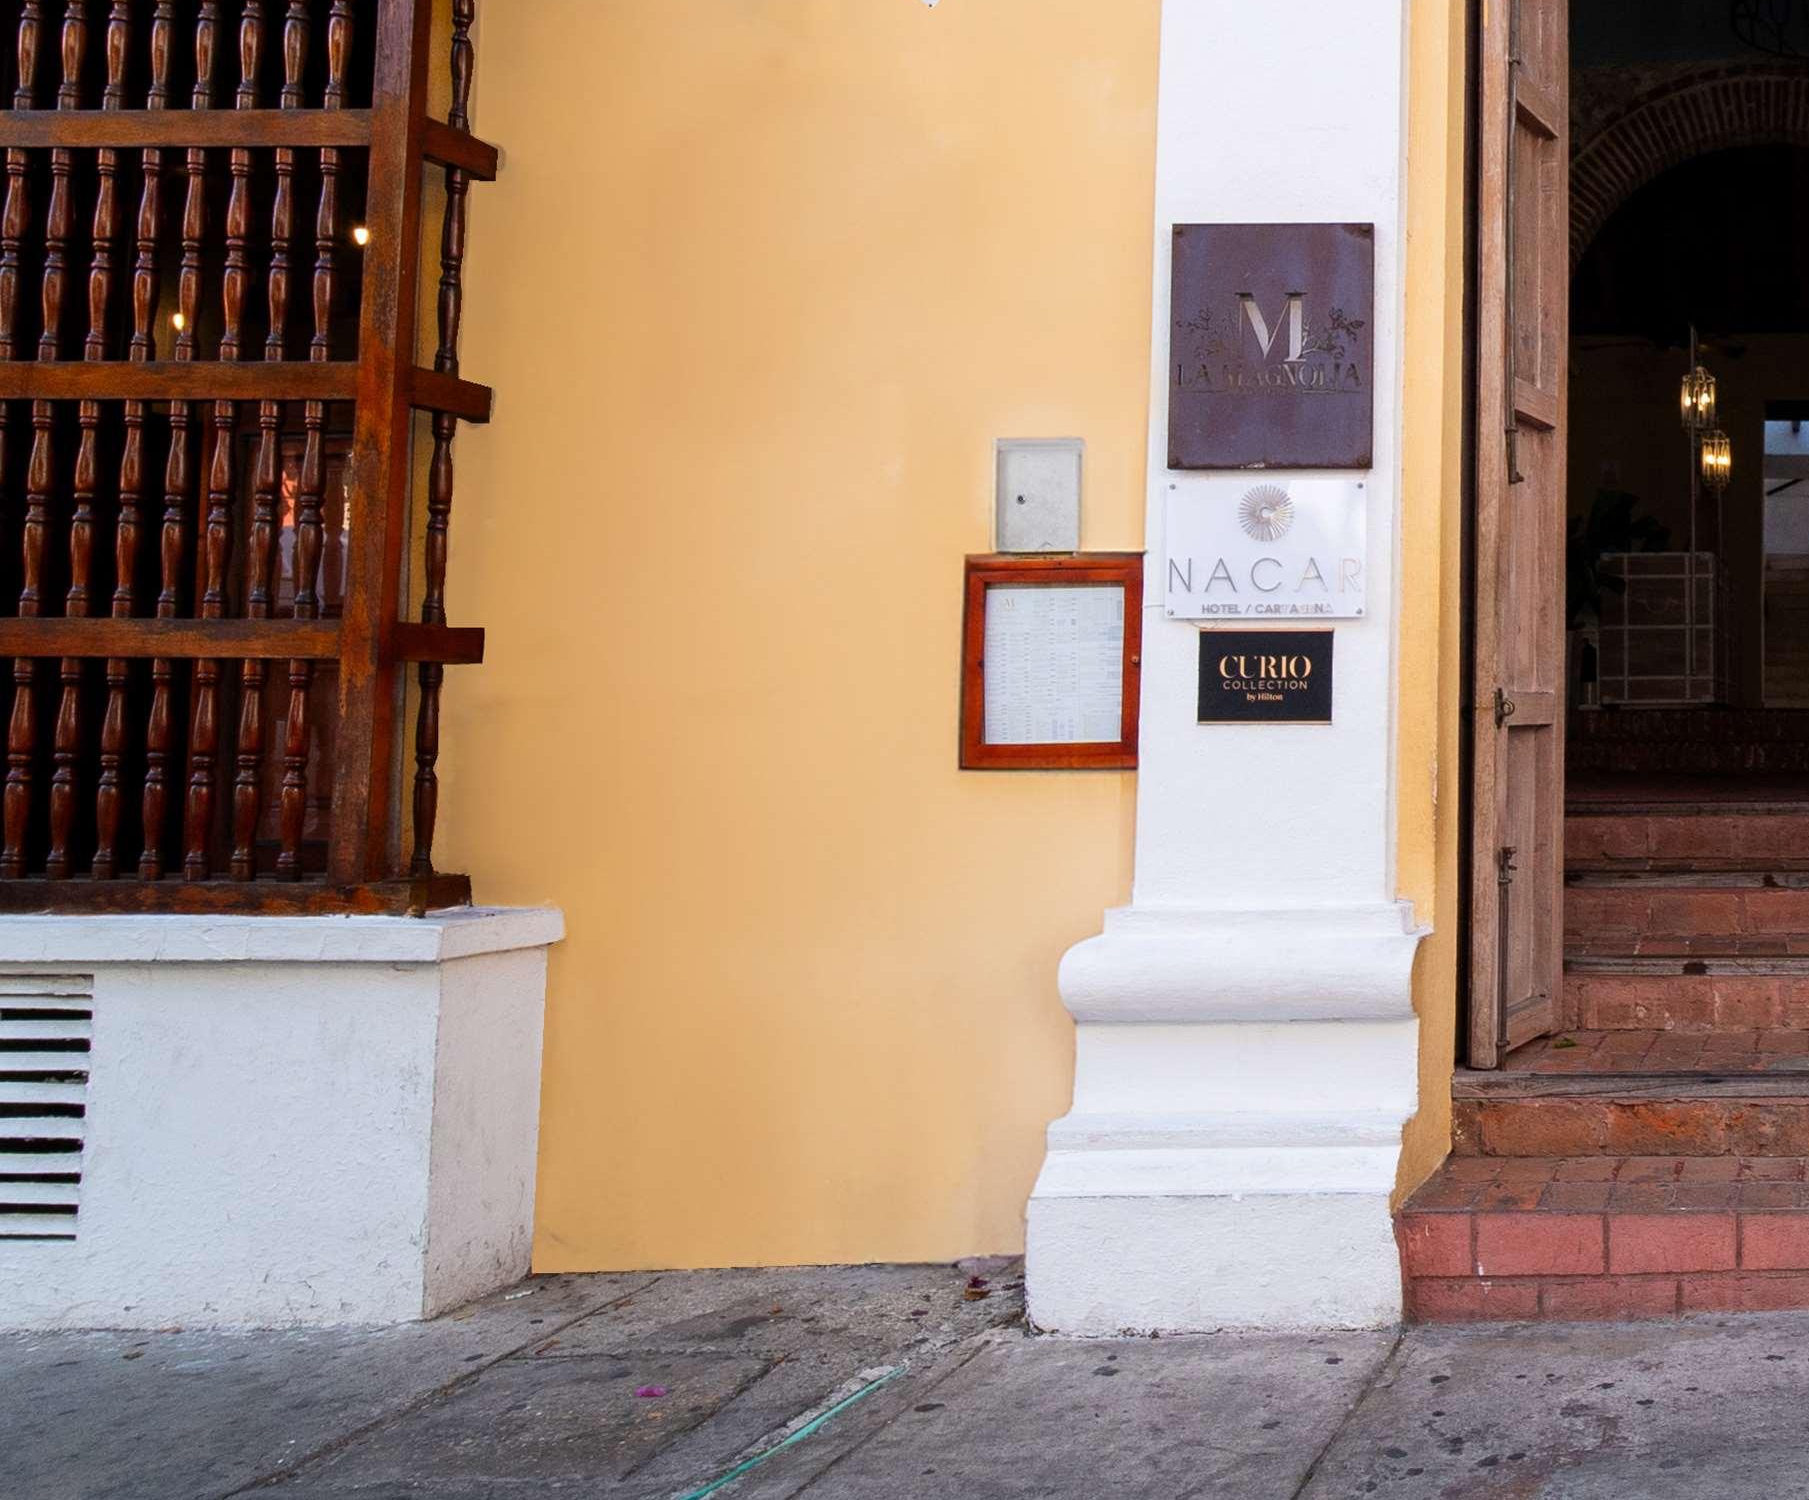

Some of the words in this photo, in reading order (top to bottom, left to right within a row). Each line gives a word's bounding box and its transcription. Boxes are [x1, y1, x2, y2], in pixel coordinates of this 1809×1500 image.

[1168, 557, 1362, 593] NACAR
[1201, 603, 1241, 614] HOTEL
[1219, 655, 1312, 679] CURIO
[1222, 680, 1308, 690] COLLECTION
[1246, 693, 1256, 702] by
[1257, 692, 1284, 701] Hilton
